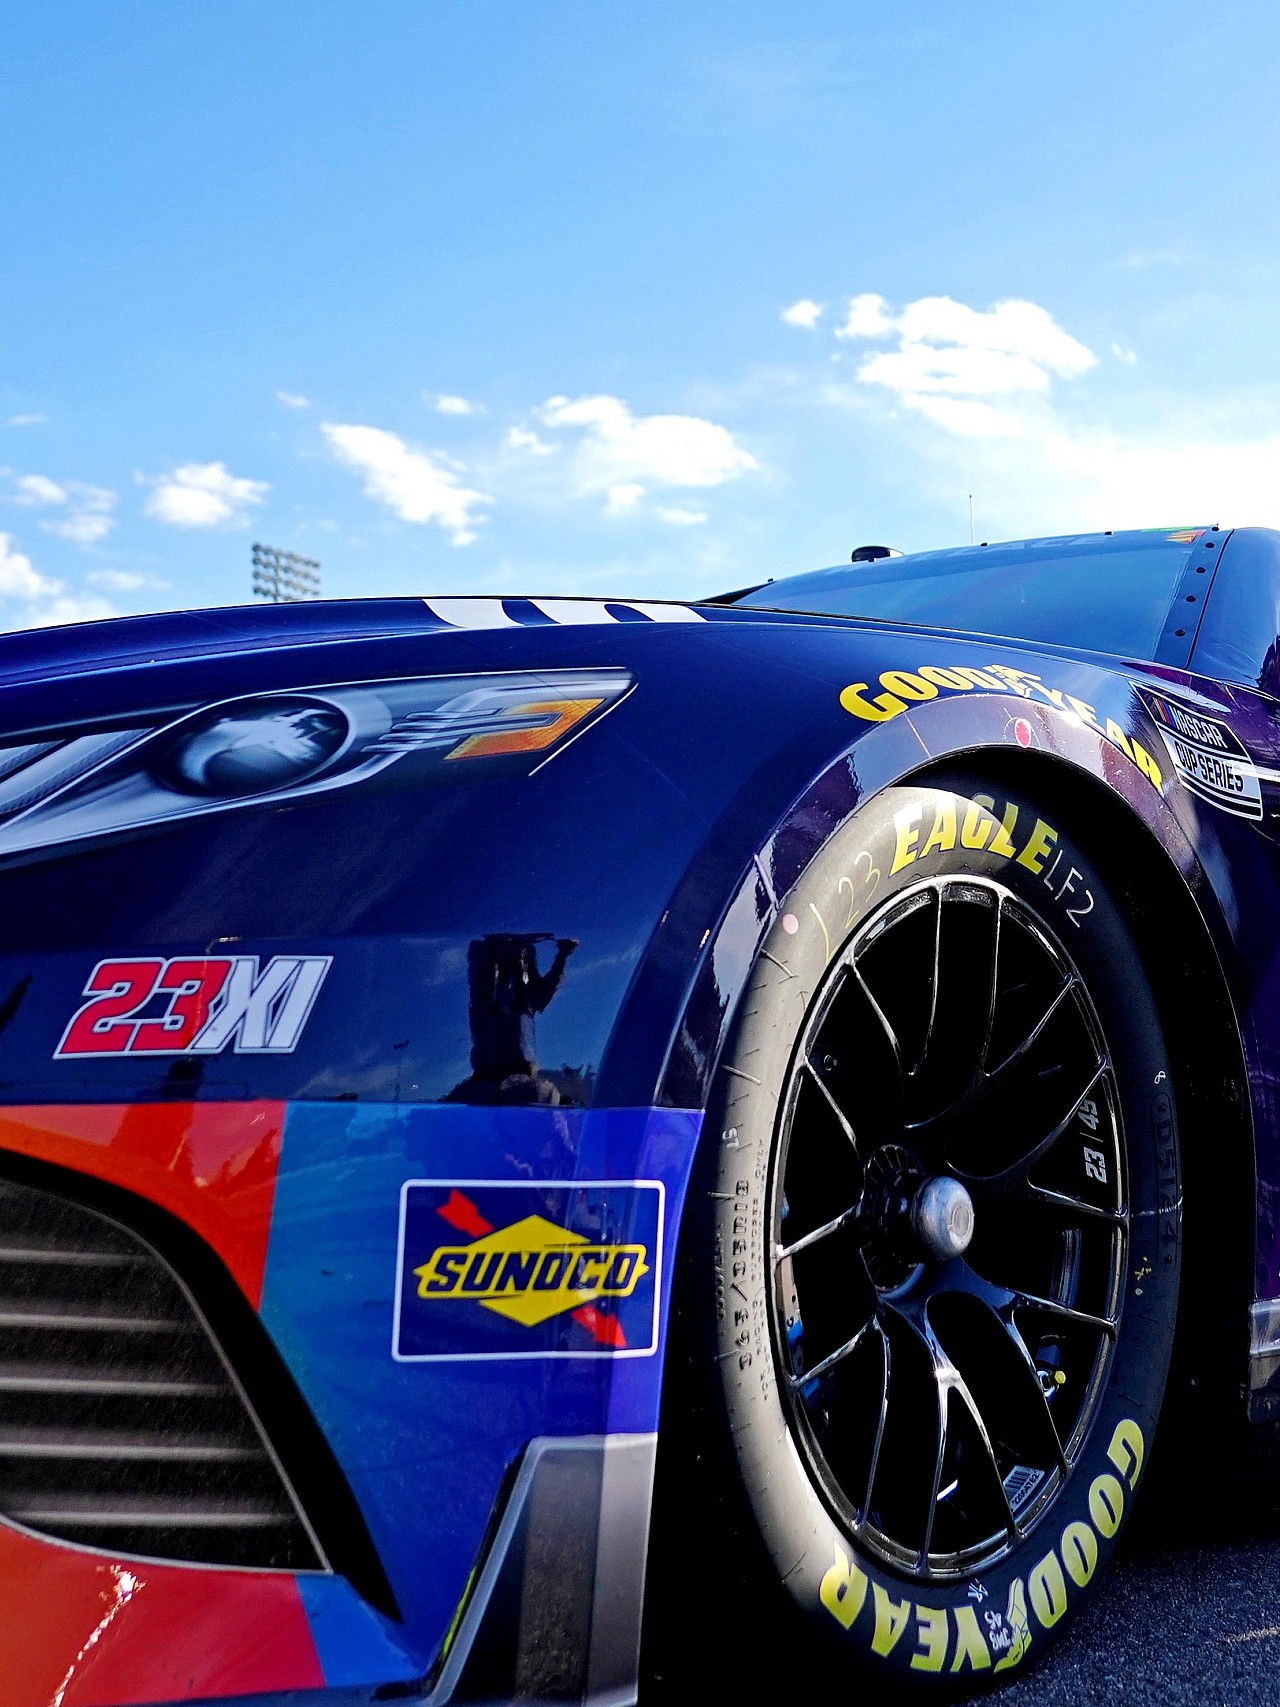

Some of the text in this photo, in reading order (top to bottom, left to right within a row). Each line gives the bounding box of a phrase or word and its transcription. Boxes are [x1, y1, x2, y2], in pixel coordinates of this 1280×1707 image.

[839, 664, 1165, 798] GOODYEAR
[1168, 705, 1229, 749] NASCAR
[1174, 740, 1244, 792] CUP SERIES
[888, 793, 1060, 877] EAGLE
[52, 955, 335, 1061] 23XI
[426, 1250, 636, 1294] SUNOCO
[819, 1418, 1145, 1675] GOODYEAR
